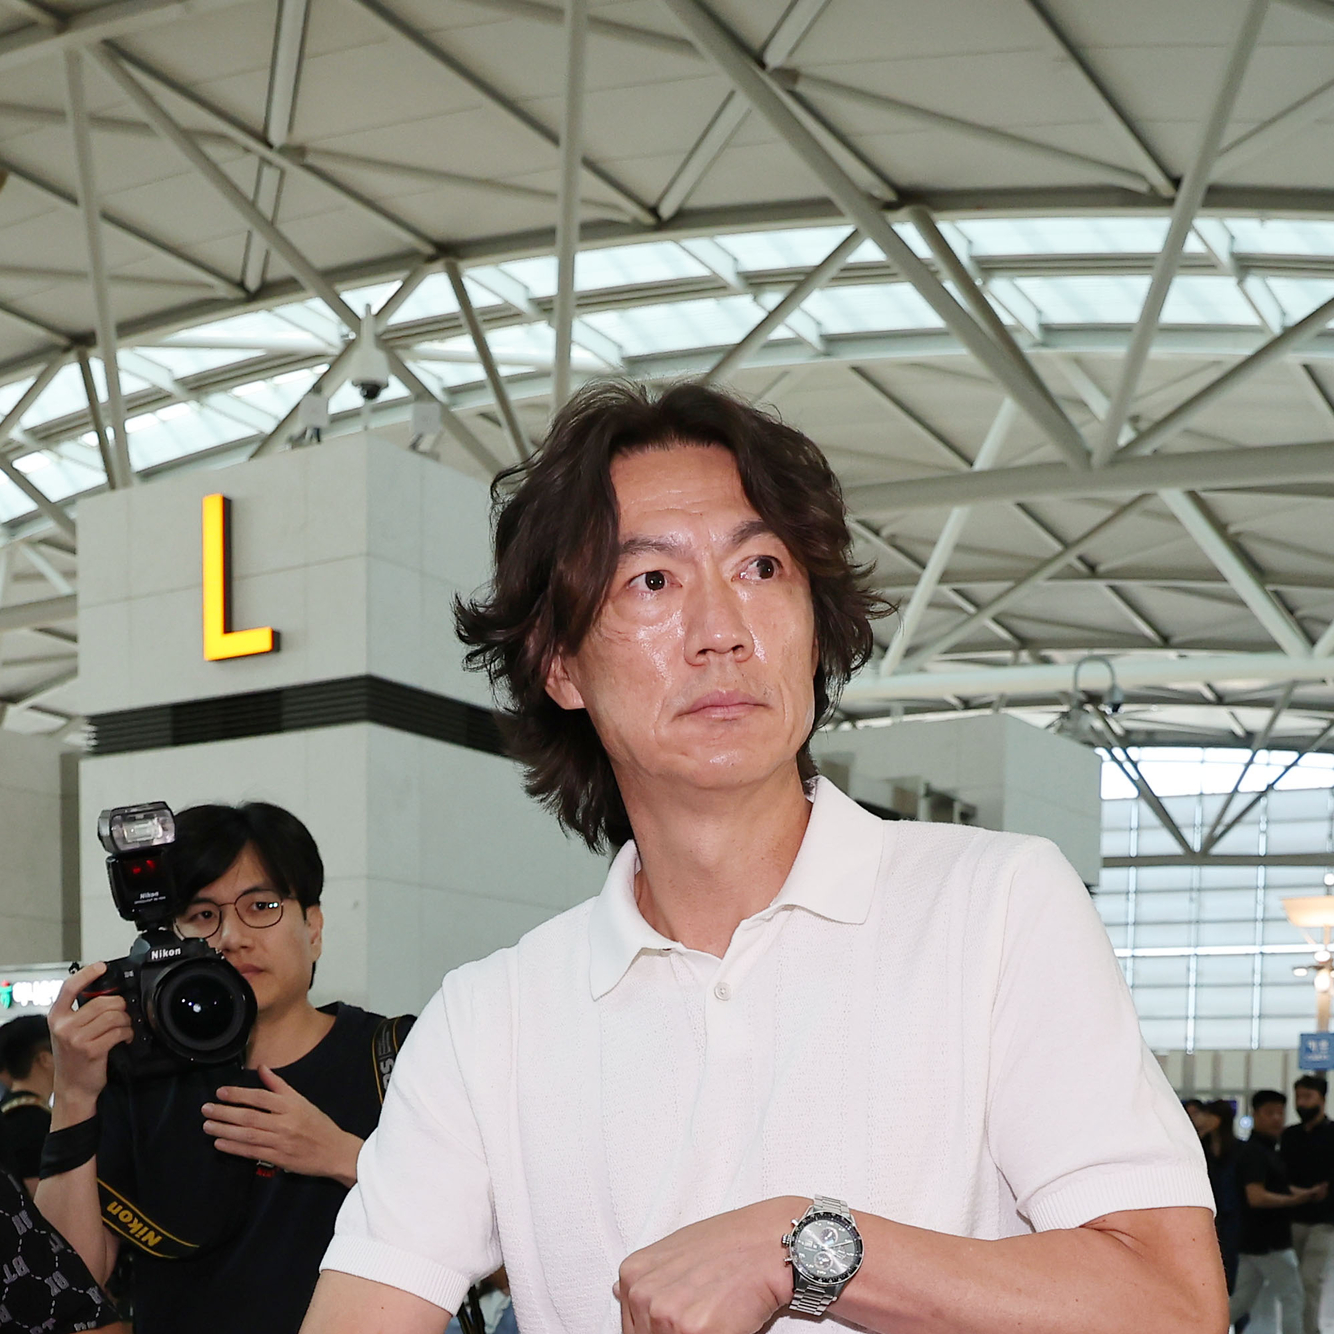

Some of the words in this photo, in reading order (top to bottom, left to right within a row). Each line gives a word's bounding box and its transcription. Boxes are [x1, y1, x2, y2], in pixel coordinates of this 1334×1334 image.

[202, 493, 278, 661] L
[151, 947, 181, 960] Nikon
[107, 1201, 163, 1247] Nikon
